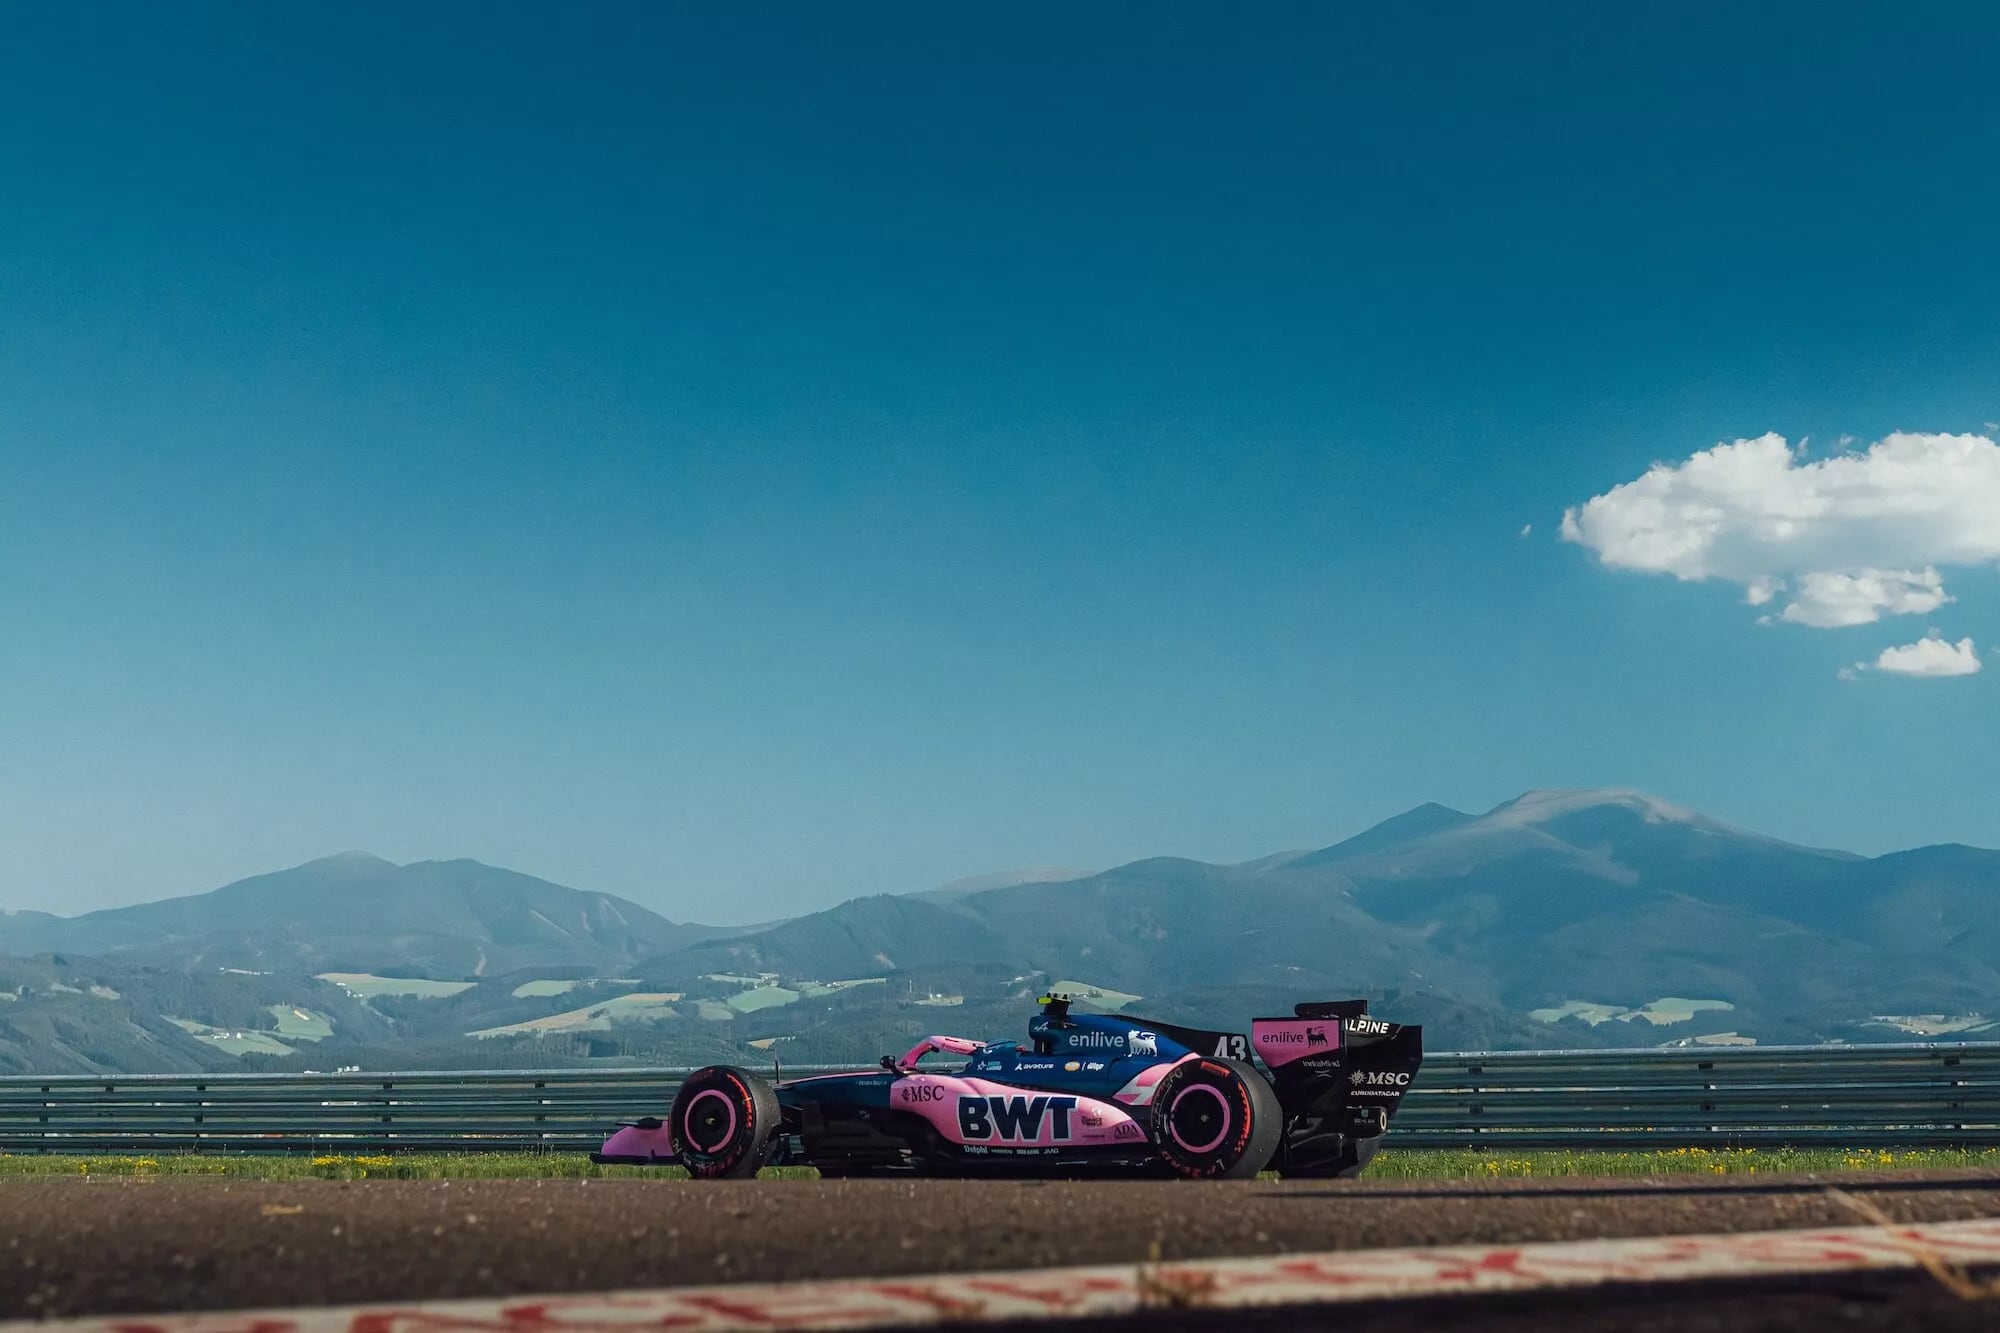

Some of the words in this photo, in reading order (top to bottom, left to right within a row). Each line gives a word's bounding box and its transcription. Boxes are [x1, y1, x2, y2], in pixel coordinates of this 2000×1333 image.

[1069, 1032, 1124, 1047] enilive
[1262, 1031, 1304, 1044] enilive
[1214, 1035, 1247, 1060] 43
[1022, 1062, 1054, 1071] avature
[1367, 1071, 1410, 1086] MSC
[911, 1085, 945, 1102] MSC
[957, 1096, 1078, 1142] BWT
